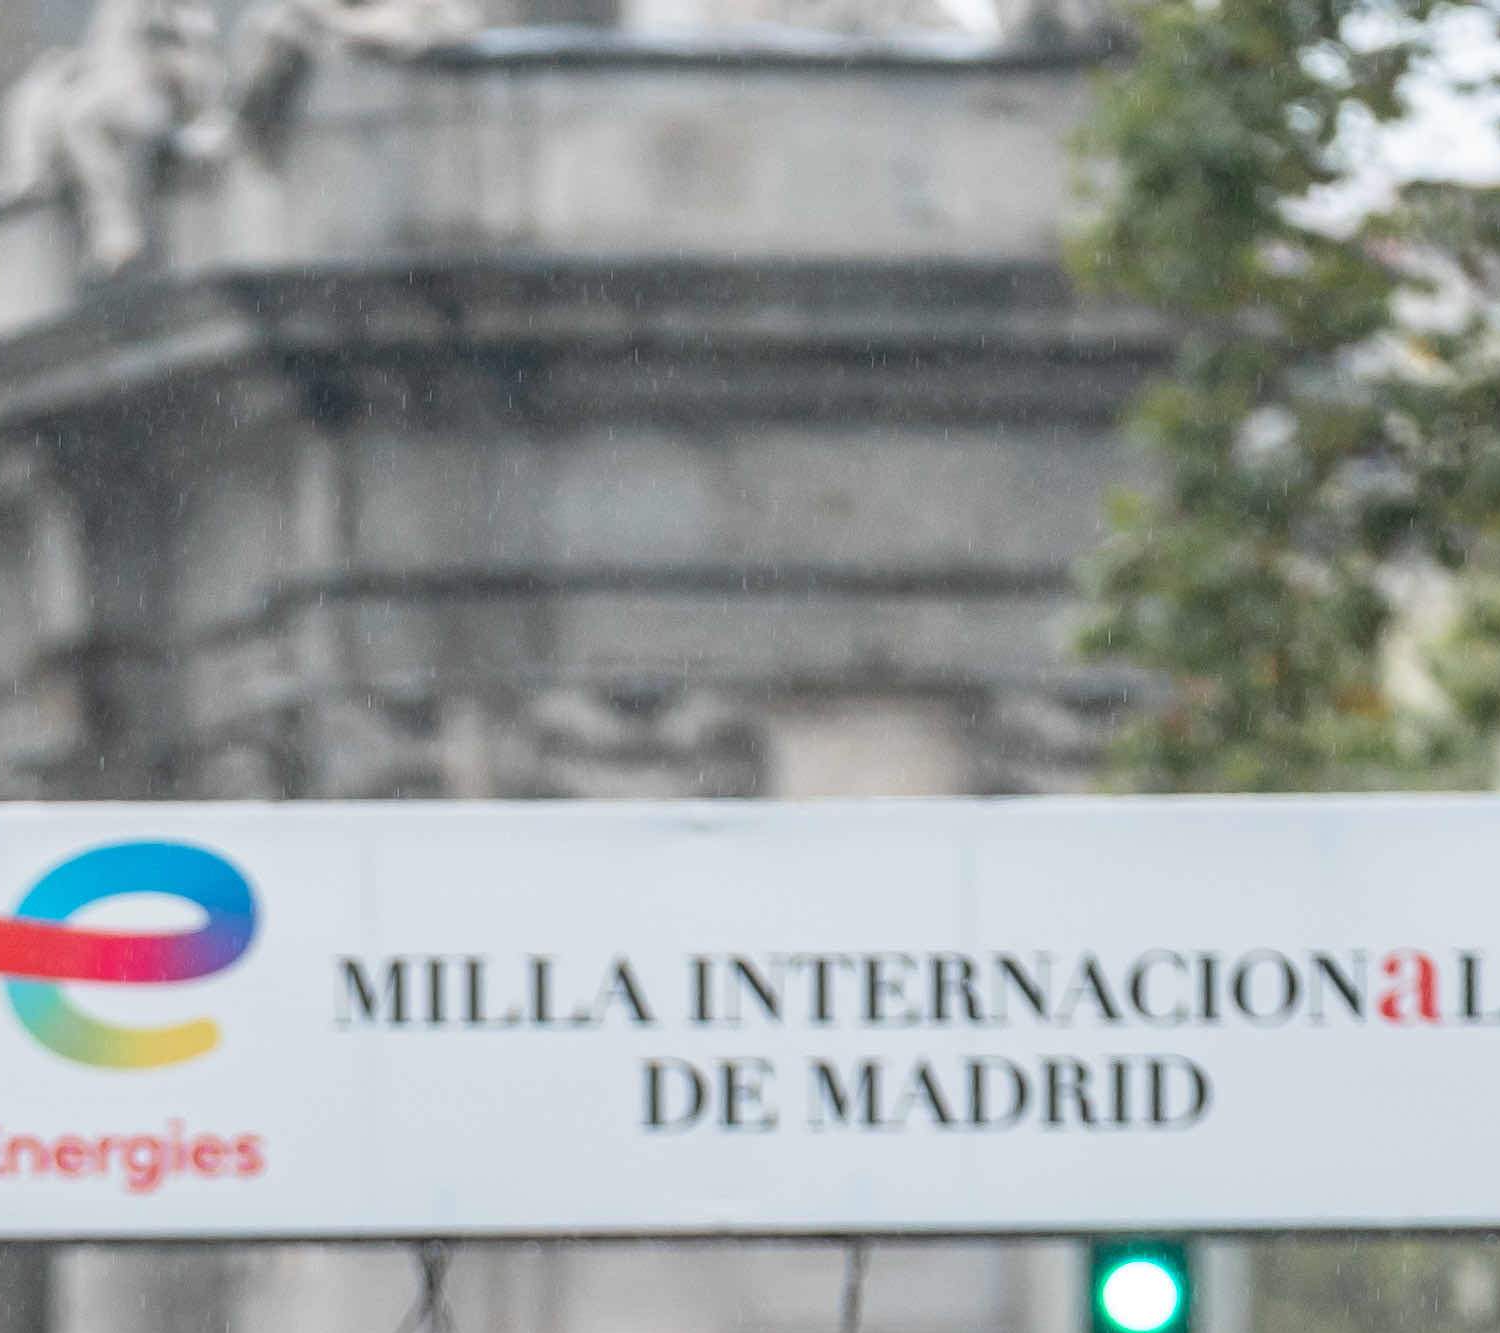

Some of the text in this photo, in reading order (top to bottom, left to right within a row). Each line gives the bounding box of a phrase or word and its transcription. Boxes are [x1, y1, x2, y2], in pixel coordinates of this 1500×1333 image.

[334, 952, 656, 1027] MILLA
[639, 1054, 1215, 1133] DE MADRID
